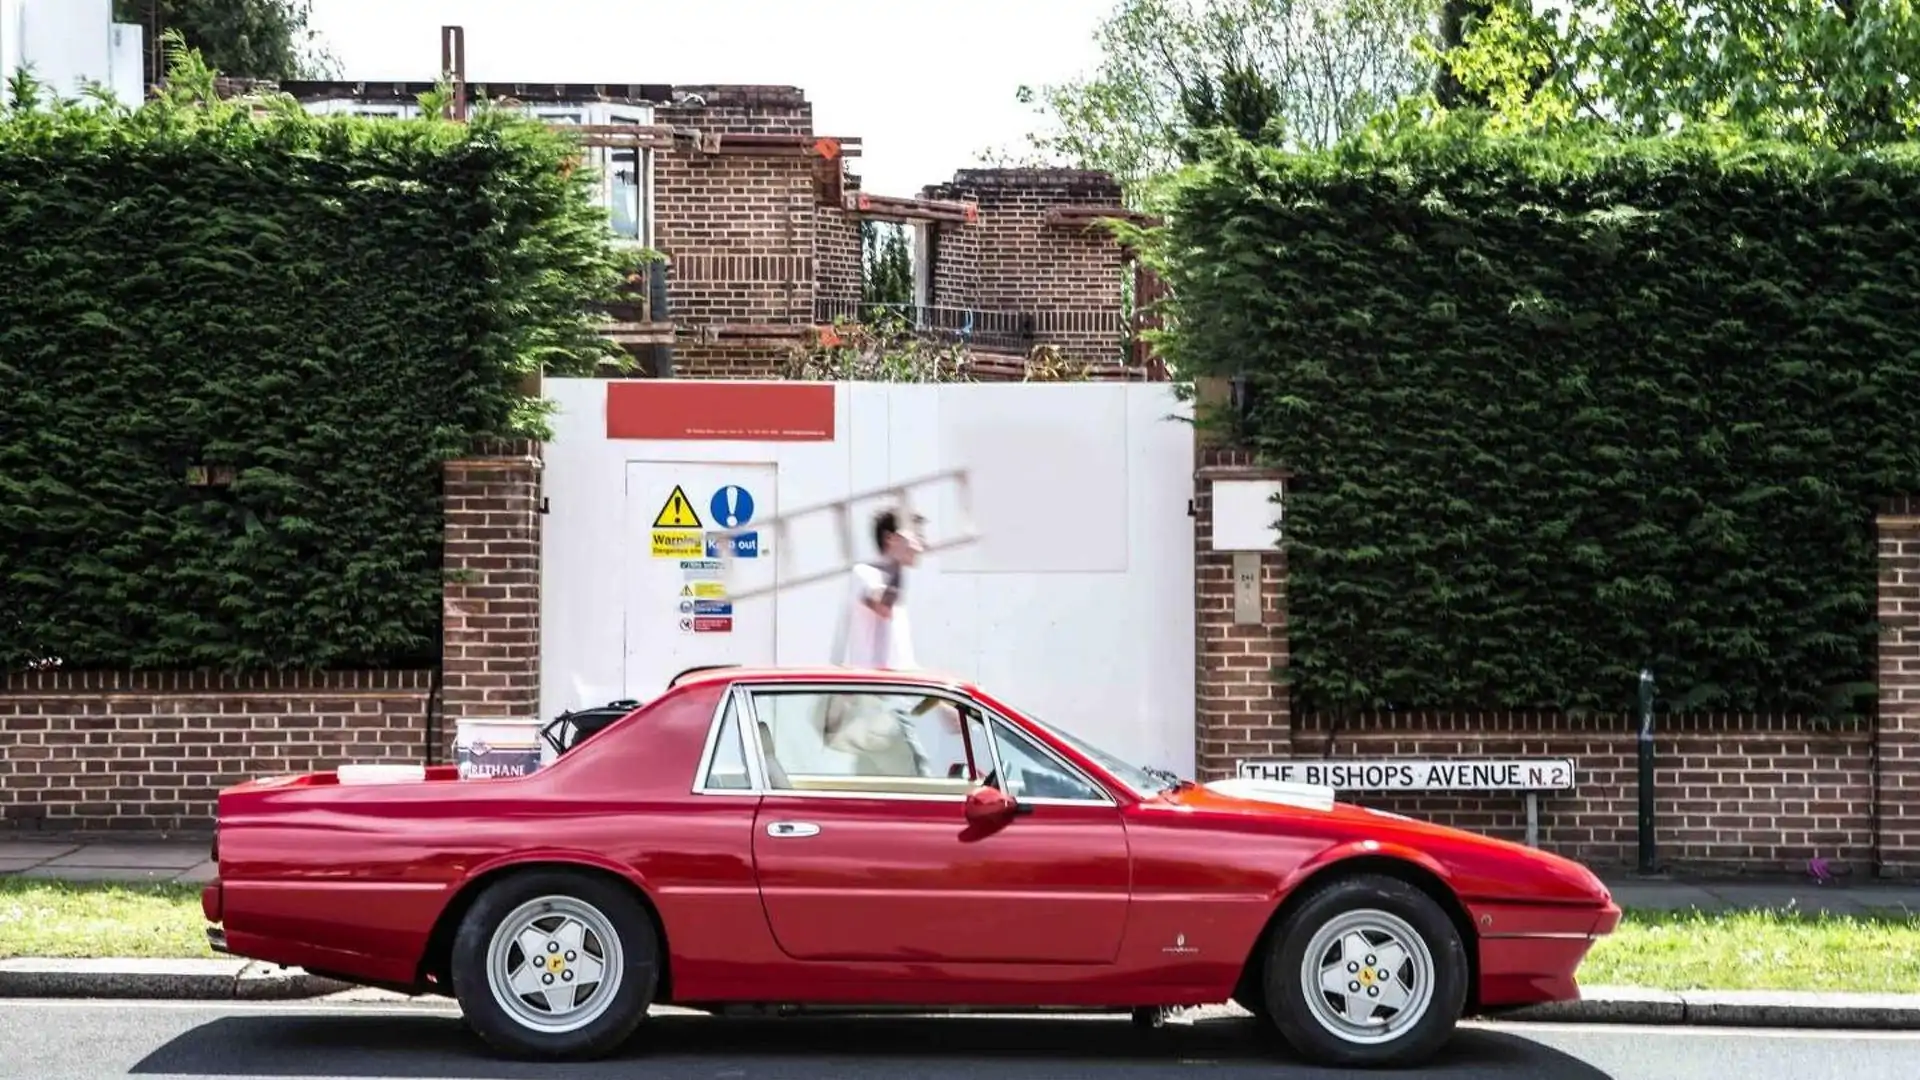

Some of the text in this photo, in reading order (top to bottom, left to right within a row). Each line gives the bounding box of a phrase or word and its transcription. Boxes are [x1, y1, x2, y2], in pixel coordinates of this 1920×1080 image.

[708, 540, 756, 549] Kp out
[462, 764, 525, 777] RETHANE
[1246, 766, 1294, 782] THE
[1306, 766, 1411, 786] BISHOPS
